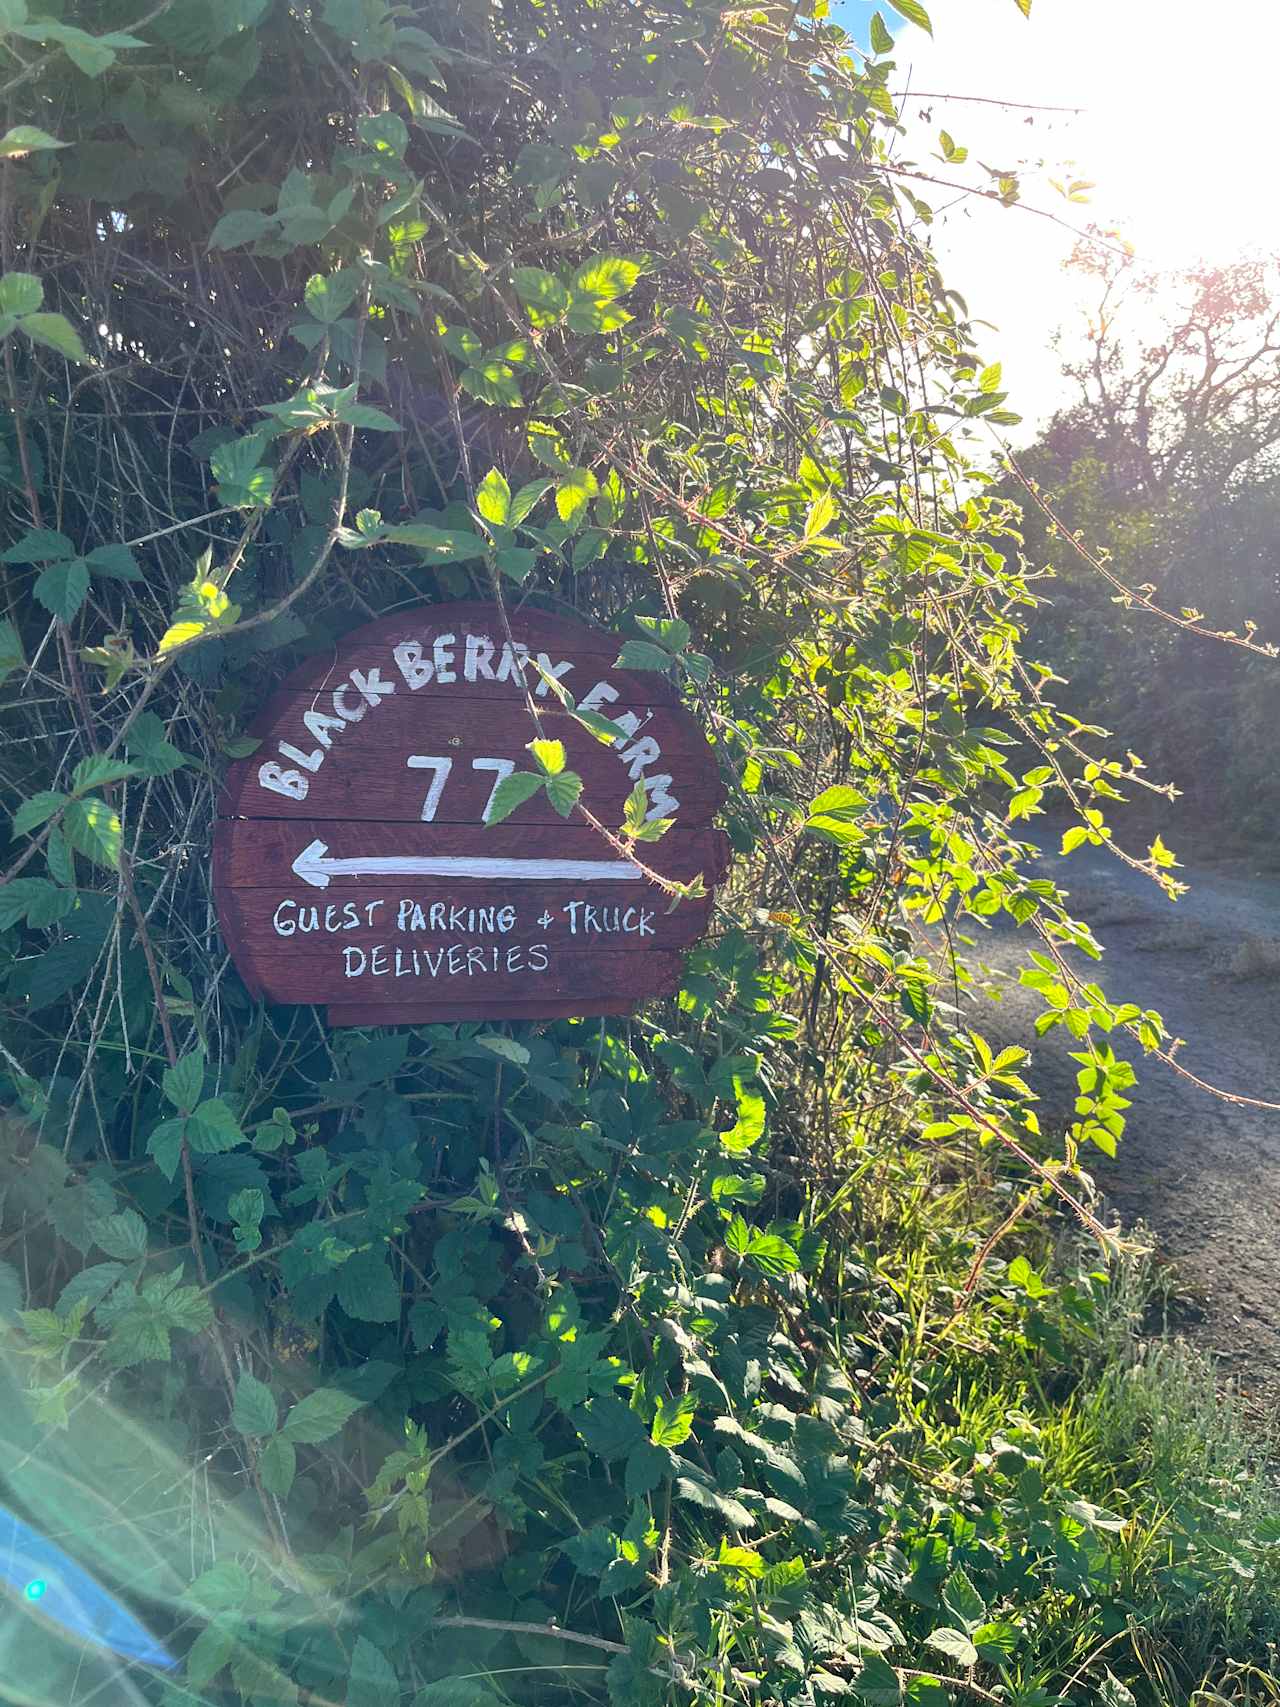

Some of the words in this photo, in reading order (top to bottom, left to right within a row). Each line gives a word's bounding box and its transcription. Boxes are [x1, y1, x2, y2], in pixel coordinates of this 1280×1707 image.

[573, 680, 681, 822] FARM
[407, 755, 516, 823] 77
[273, 899, 385, 936] GUEST
[397, 900, 517, 933] PARKING
[562, 901, 657, 936] TRUCK
[342, 944, 549, 977] DELIVERIES
